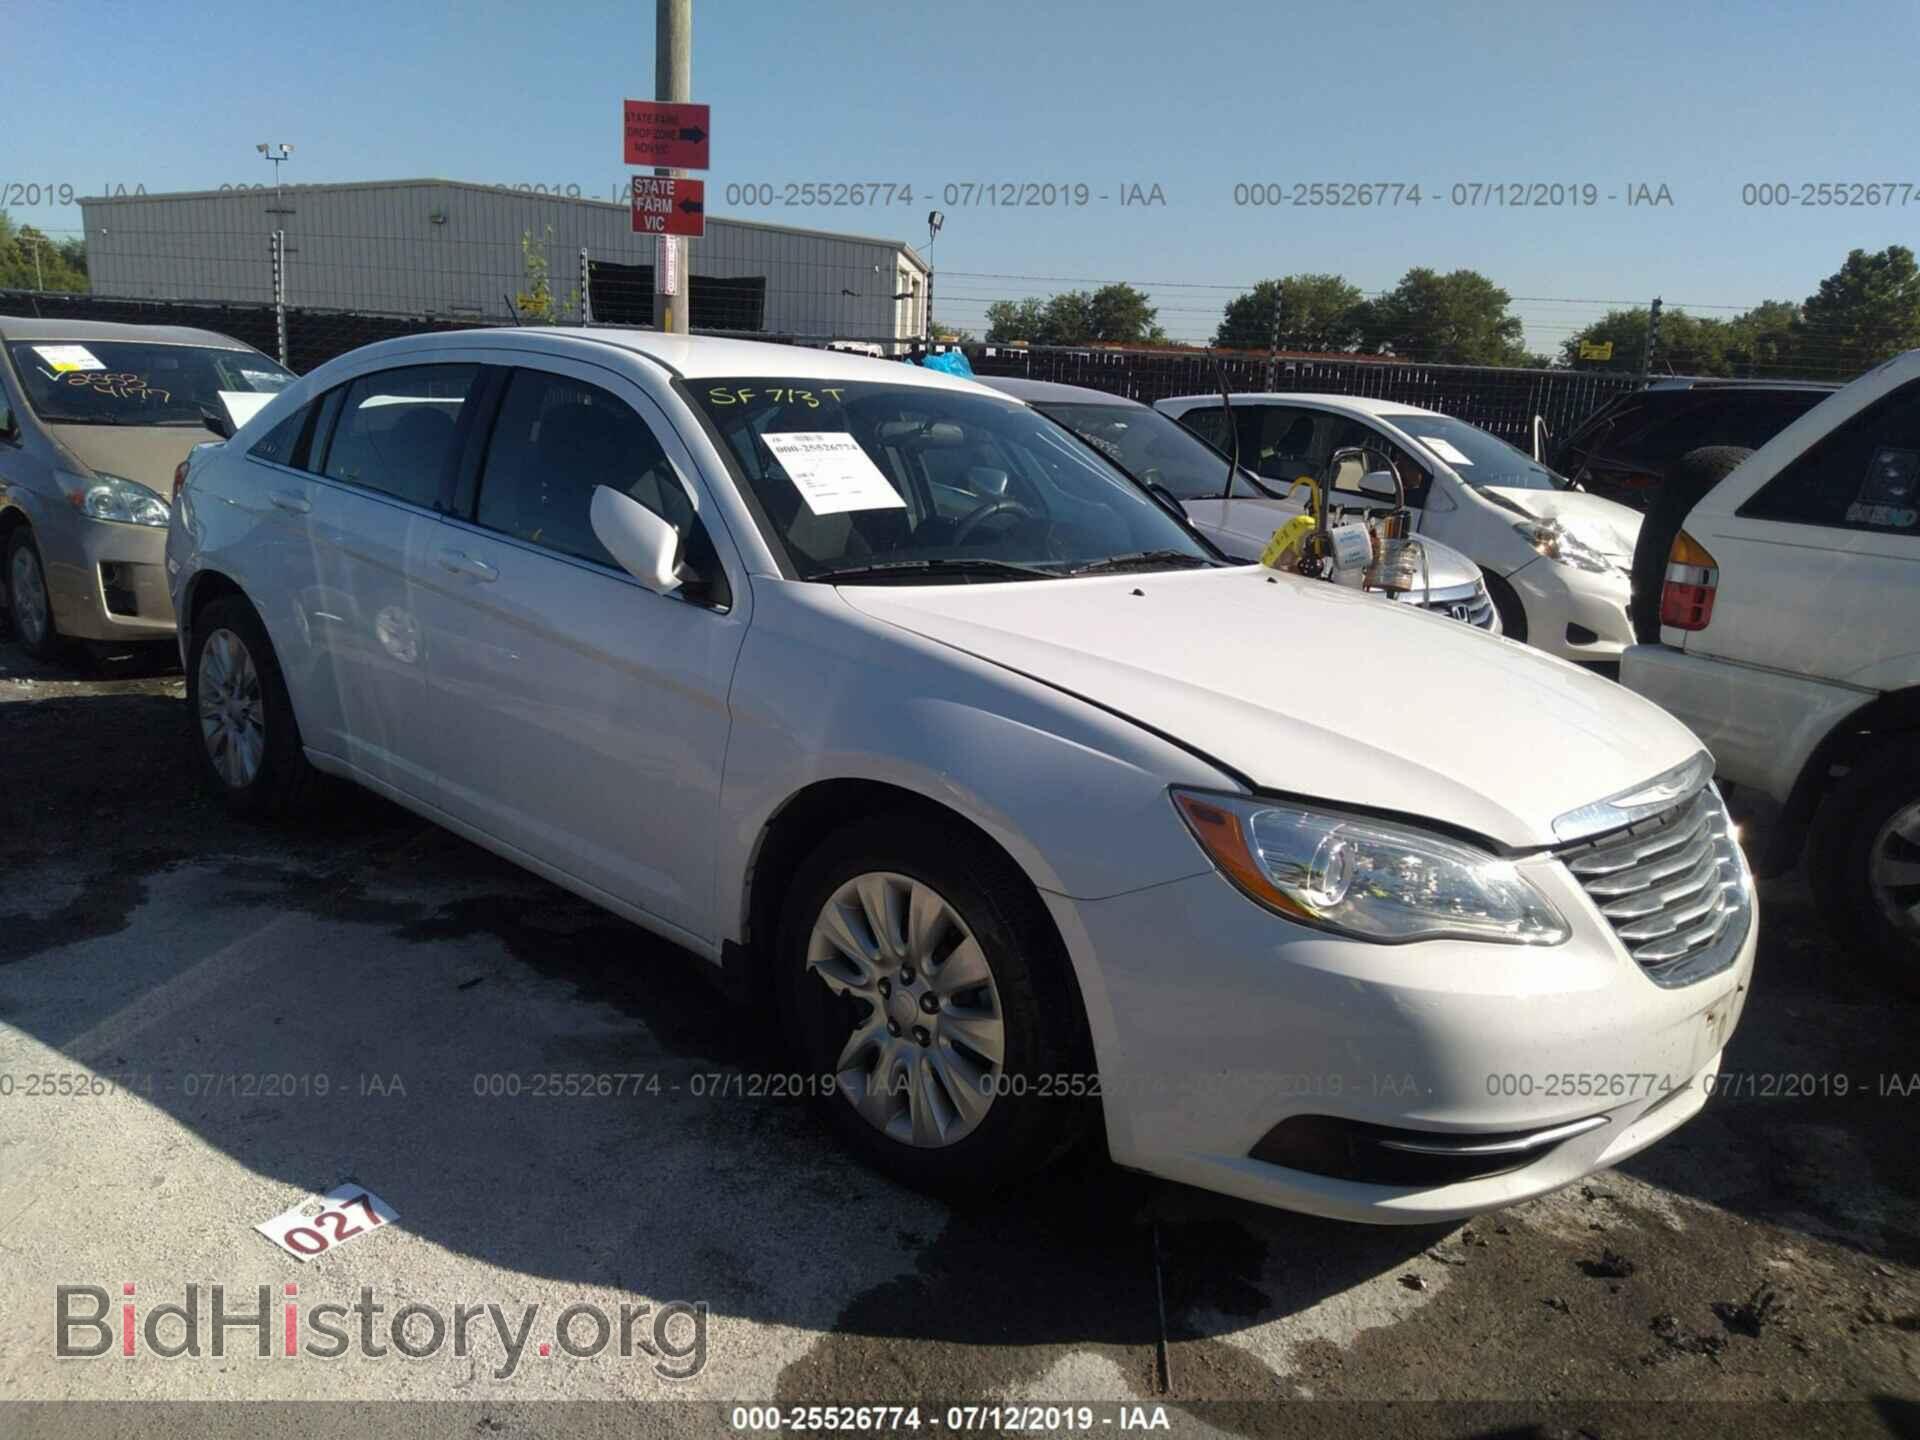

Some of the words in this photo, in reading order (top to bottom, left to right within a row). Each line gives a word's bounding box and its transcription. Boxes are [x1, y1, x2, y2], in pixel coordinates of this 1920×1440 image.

[634, 178, 675, 196] STATE
[636, 199, 673, 213] FARM
[644, 216, 665, 231] VIC
[709, 387, 755, 405] SF
[766, 388, 819, 408] 713
[821, 388, 845, 402] T
[284, 1193, 382, 1255] 027
